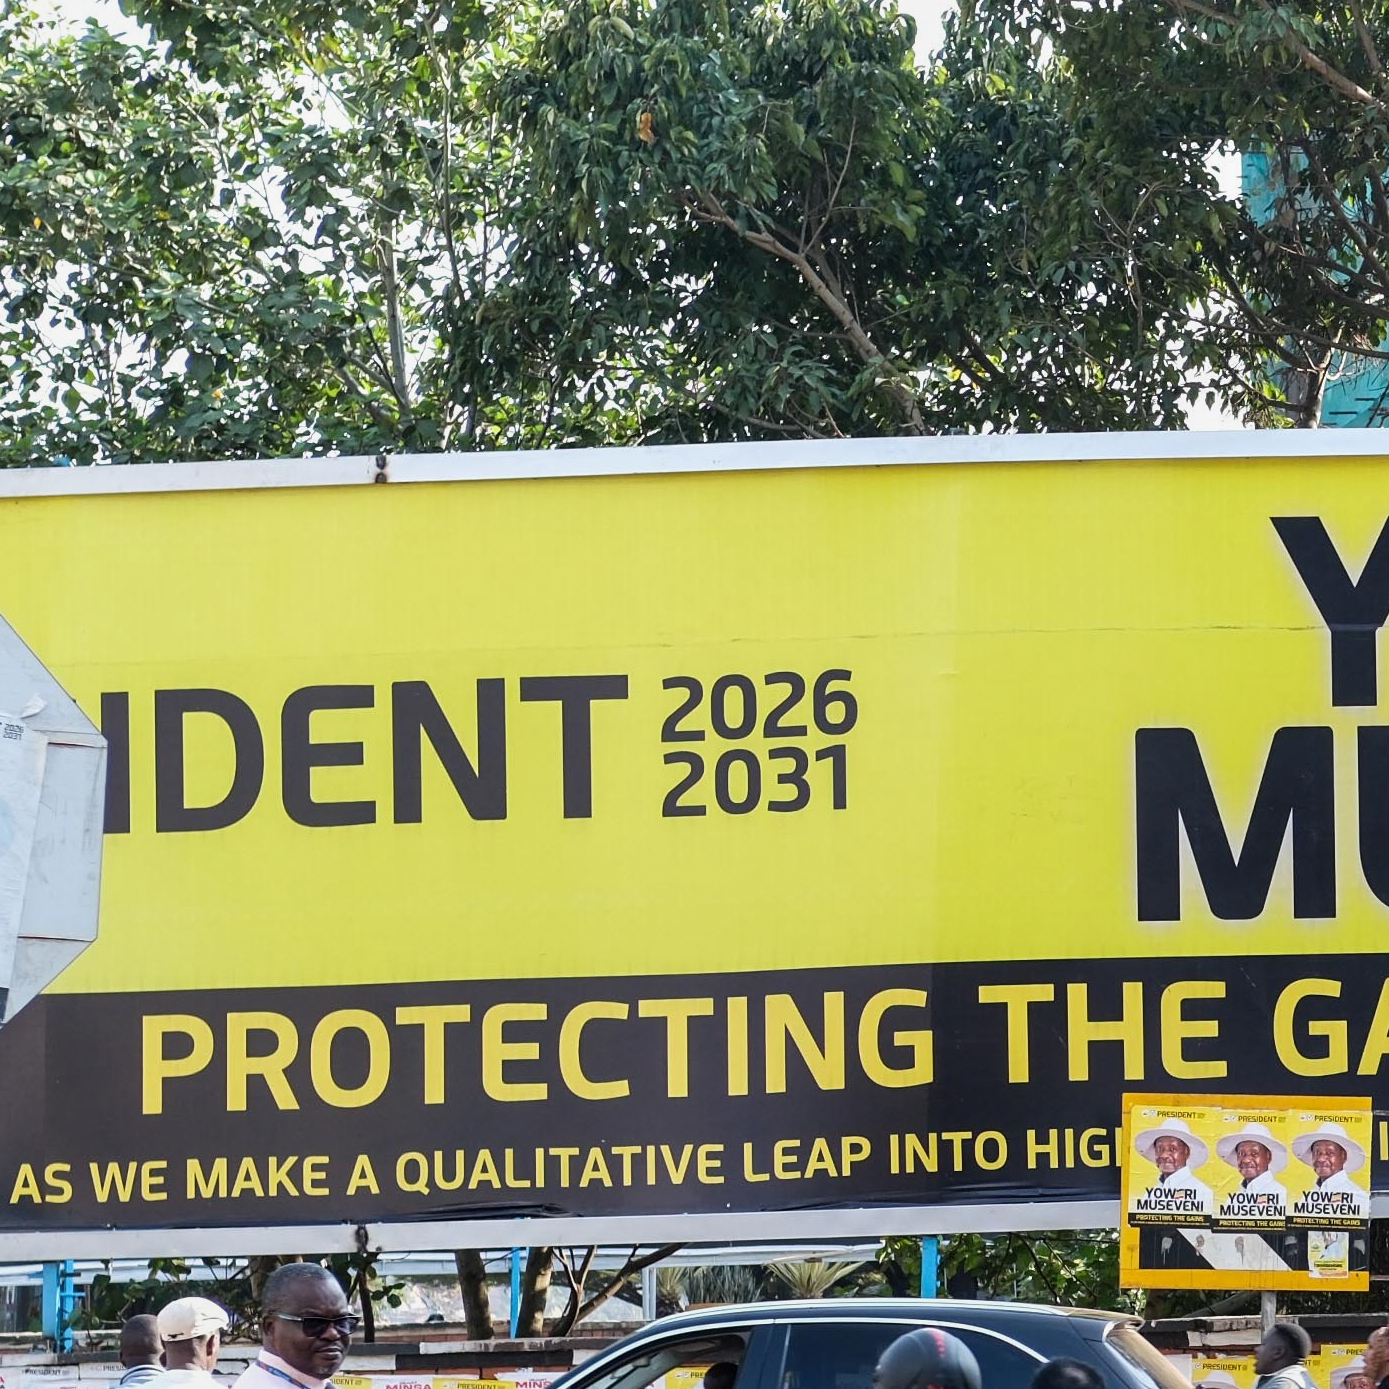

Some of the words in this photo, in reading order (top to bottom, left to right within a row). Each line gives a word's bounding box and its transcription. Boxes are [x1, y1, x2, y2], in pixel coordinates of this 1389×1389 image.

[662, 669, 858, 743] 2026
[102, 675, 628, 834] IDENT
[662, 744, 848, 818] 2031
[142, 988, 934, 1115] PROTECTING
[979, 980, 1227, 1084] THE
[1157, 1111, 1196, 1119] PRESIDENT
[10, 1163, 72, 1204] AS
[90, 1160, 168, 1202] WE
[186, 1154, 329, 1200] MAKE
[347, 1154, 380, 1195] A
[396, 1143, 725, 1197] QUALITATIVE
[744, 1136, 871, 1181] LEAP
[890, 1131, 1008, 1173] INTO
[1146, 1187, 1196, 1200] YOWERI
[1228, 1192, 1279, 1205] YOWERI
[1302, 1191, 1353, 1204] YOWERI
[1137, 1199, 1203, 1212] MUSEVENI
[1220, 1205, 1285, 1217] MUSEVENI
[1294, 1202, 1360, 1216] MUSEVENI
[1203, 1363, 1241, 1371] PRESIDENT
